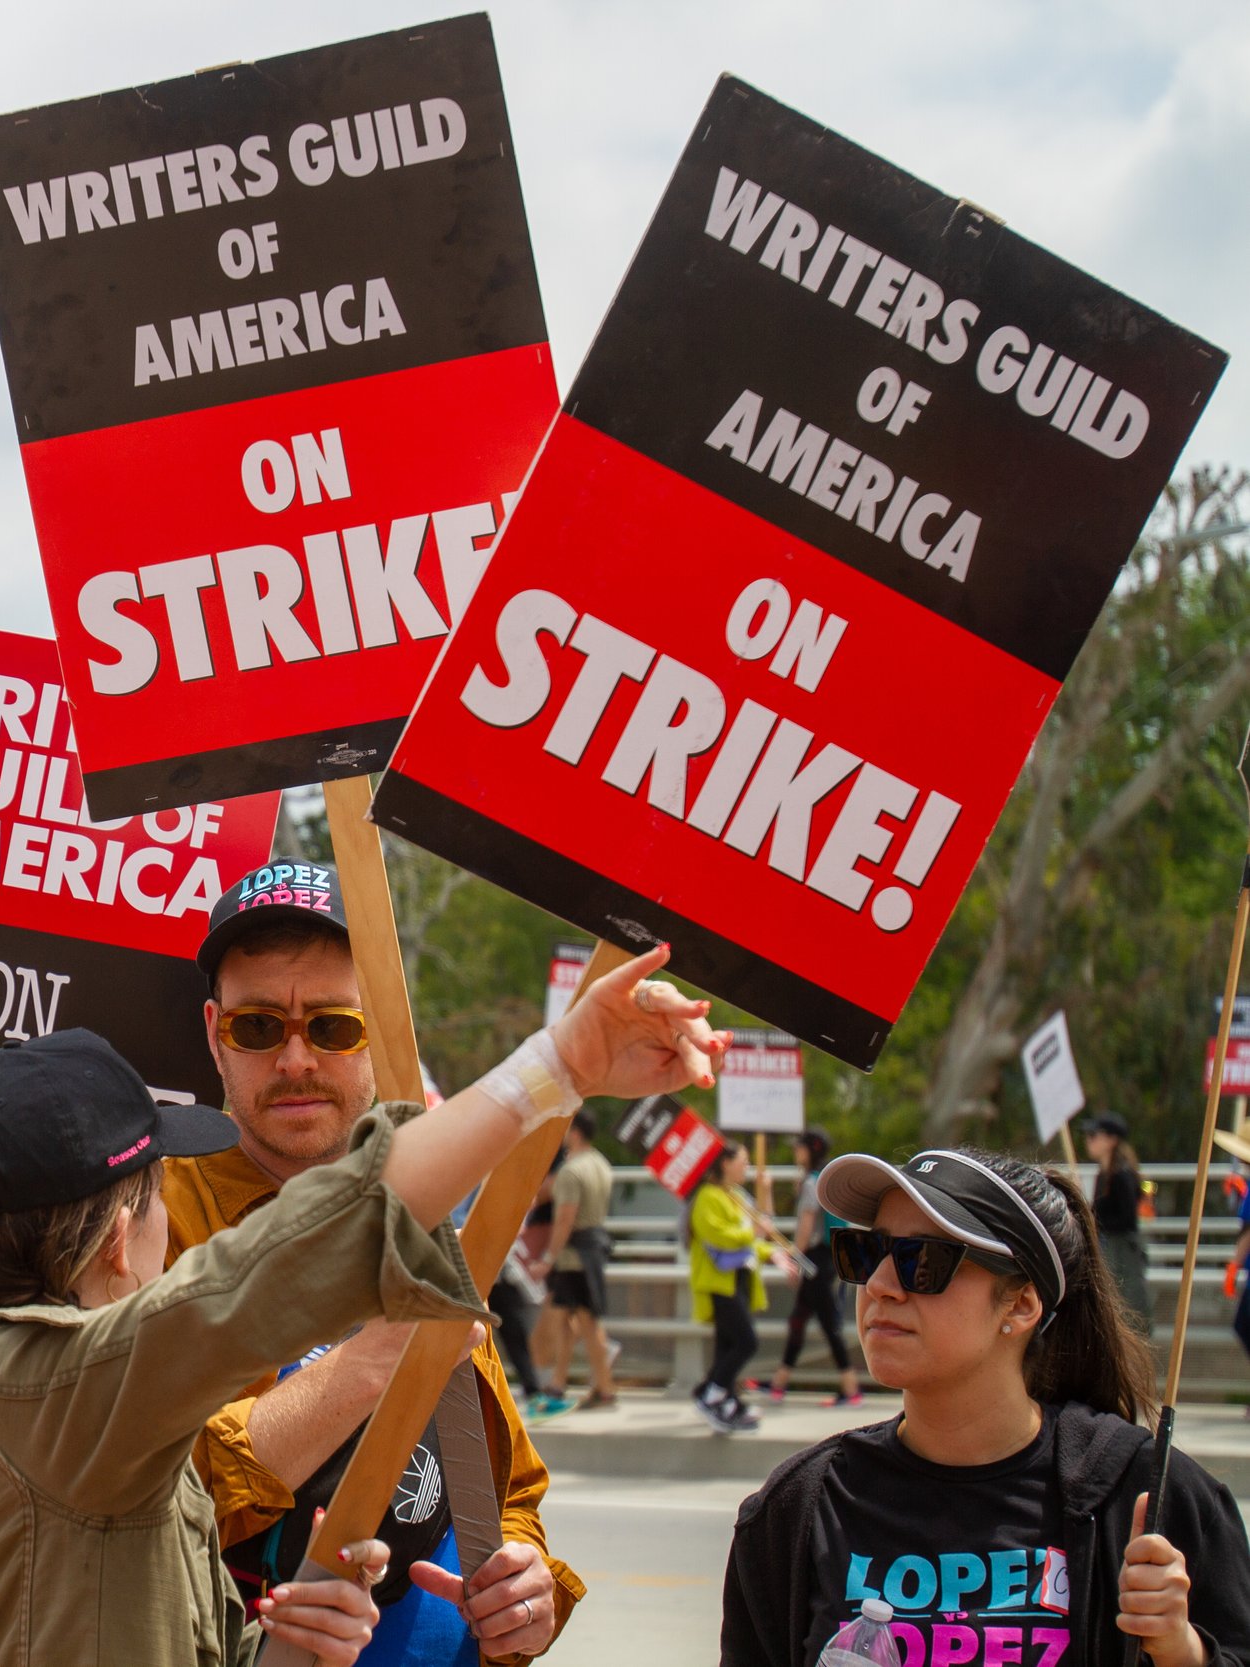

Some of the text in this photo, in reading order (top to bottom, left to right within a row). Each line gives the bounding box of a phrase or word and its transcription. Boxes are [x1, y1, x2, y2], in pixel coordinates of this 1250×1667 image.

[3, 97, 467, 245] WRITERS GUILD
[217, 221, 279, 280] OF
[134, 277, 406, 387] AMERICA
[703, 166, 1150, 459] WRITERS GUILD
[857, 366, 932, 436] OF
[241, 427, 351, 514] ON
[704, 389, 982, 583] AMERICA
[77, 491, 519, 696] STRIKE
[726, 578, 849, 693] ON
[459, 589, 962, 932] STRIKE!
[142, 803, 225, 849] OF
[238, 864, 331, 899] LOPEZ
[107, 1135, 150, 1167] Season One
